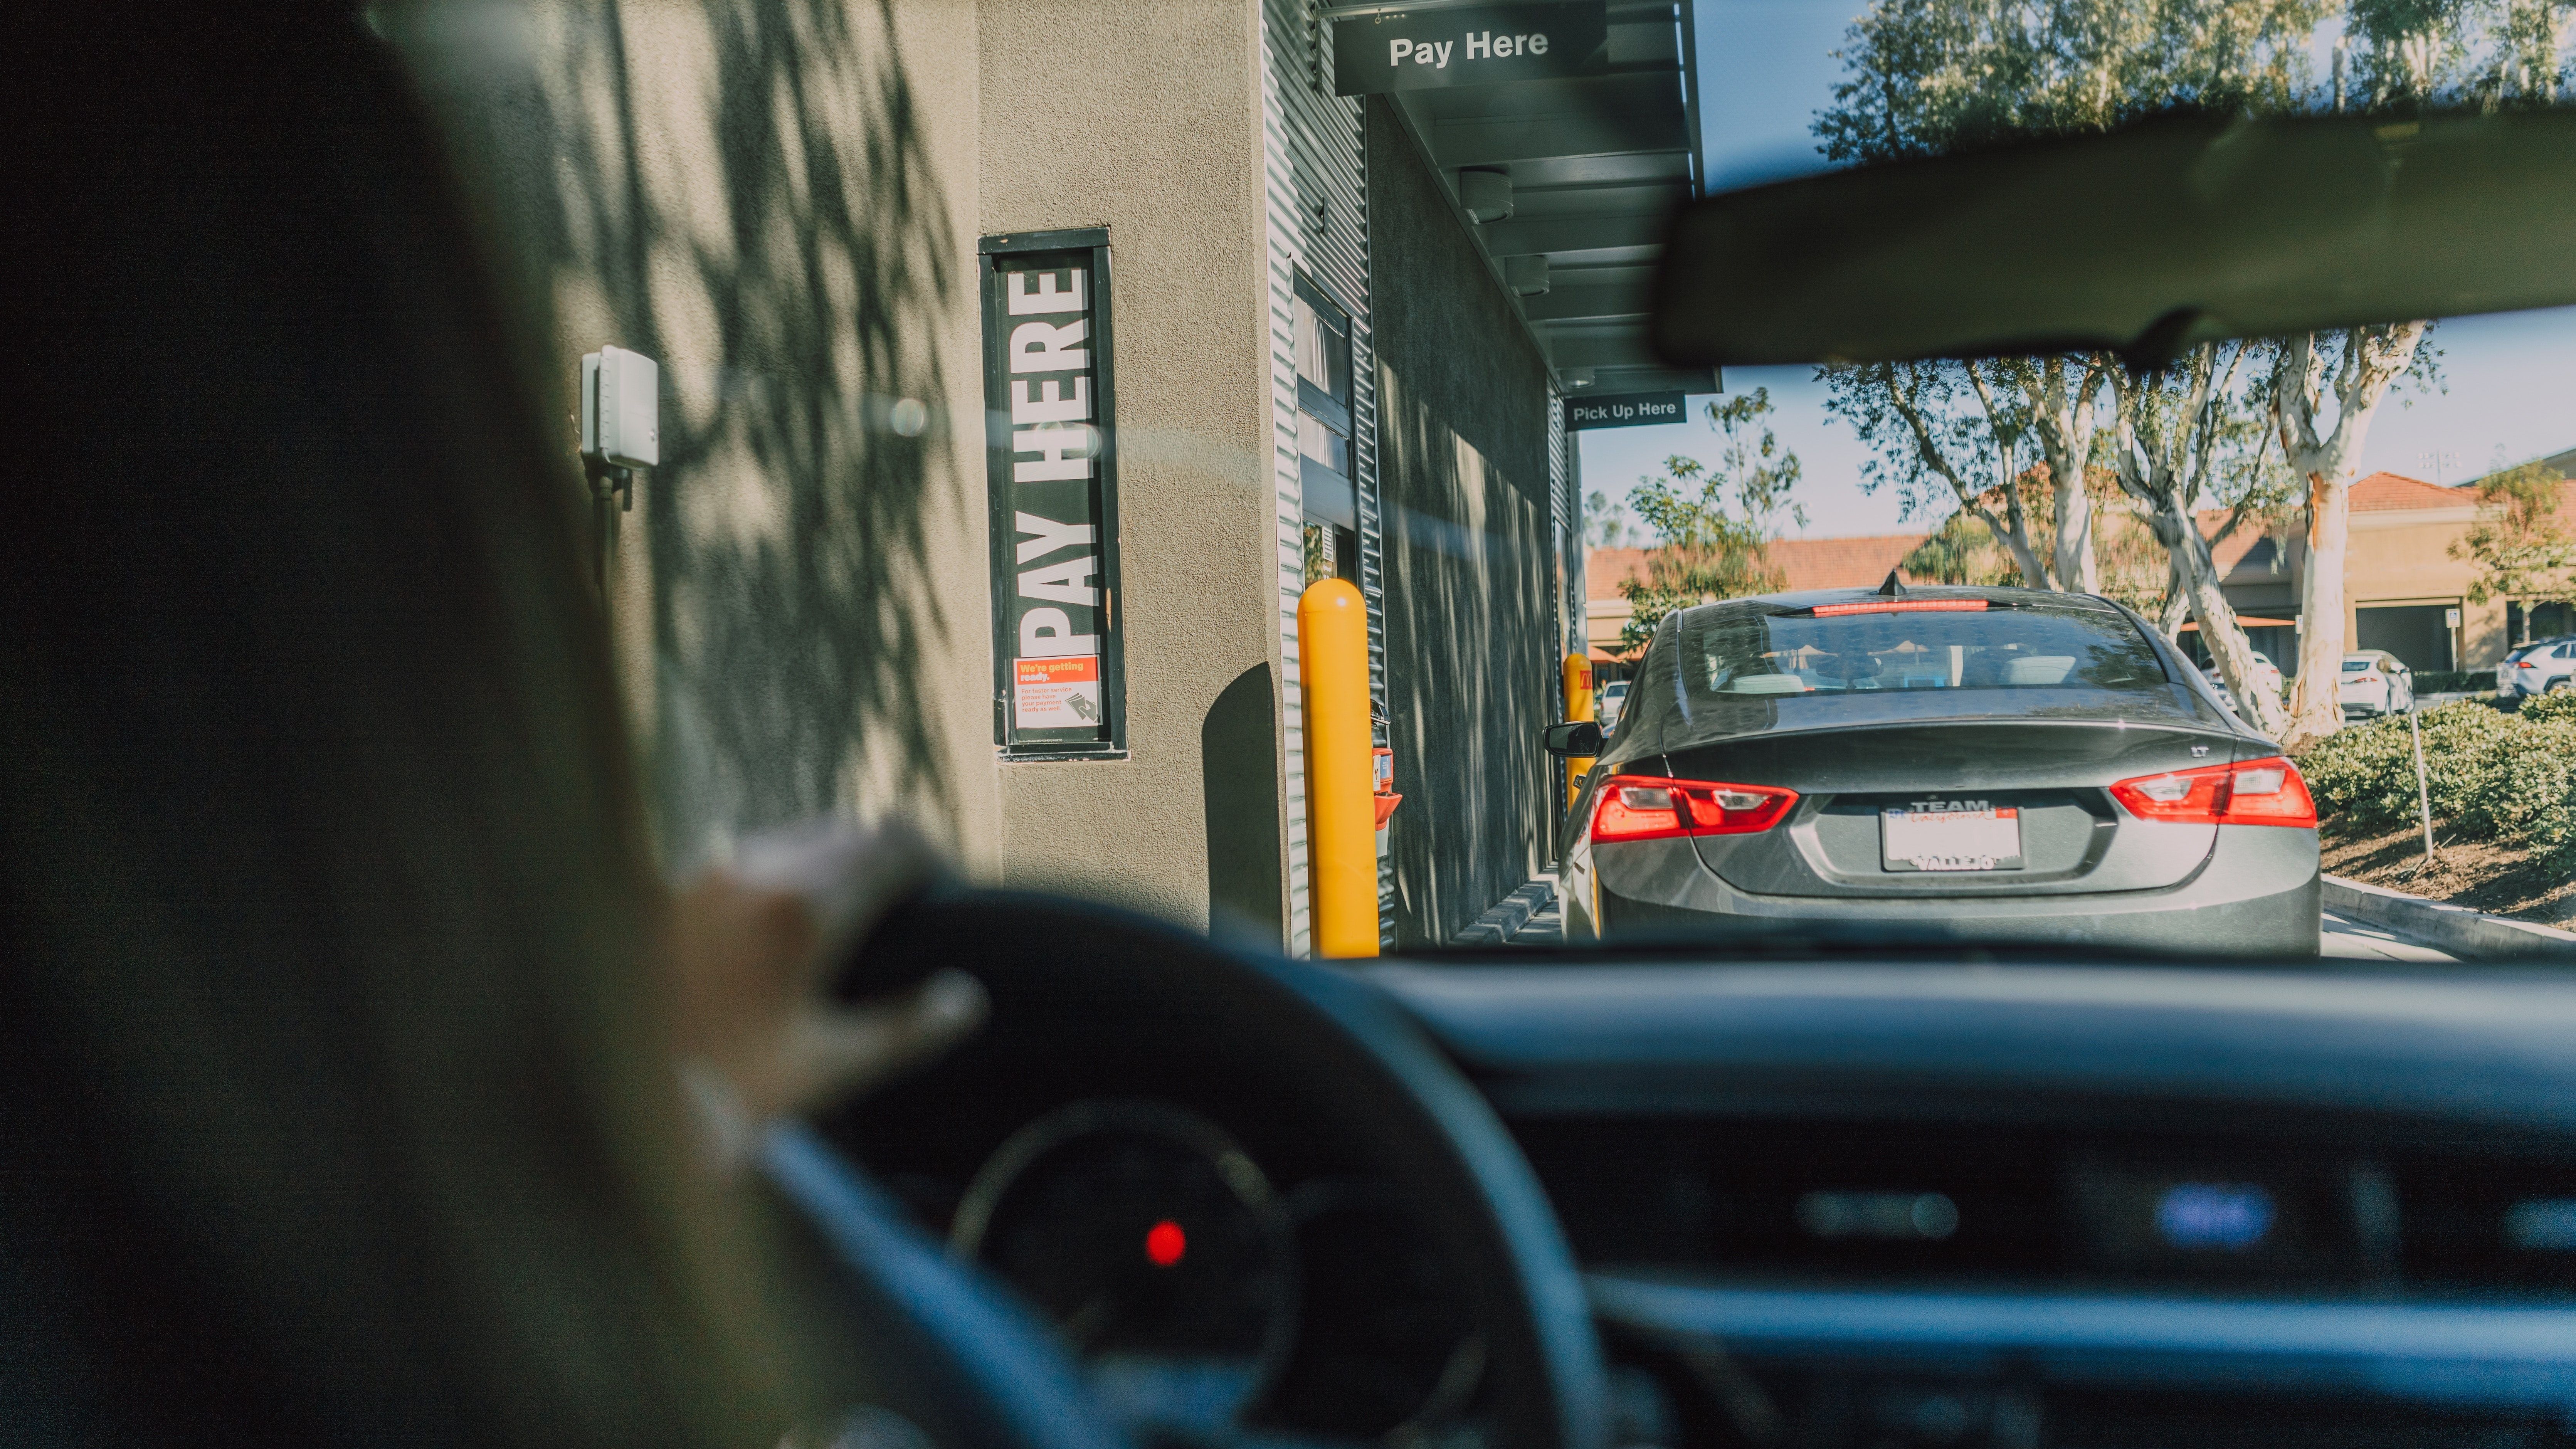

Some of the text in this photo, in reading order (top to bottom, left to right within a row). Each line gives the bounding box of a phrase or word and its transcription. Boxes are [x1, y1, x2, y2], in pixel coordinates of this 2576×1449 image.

[1389, 30, 1549, 69] Pay Here
[1574, 403, 1676, 421] Pick Up Here
[1007, 268, 1100, 657] PAY HERE
[1020, 662, 1084, 672] We're getting
[1021, 672, 1050, 682] ready.
[2191, 746, 2209, 757] LT
[1910, 800, 1989, 813] TEAM
[1917, 856, 1995, 871] VALLEJO
